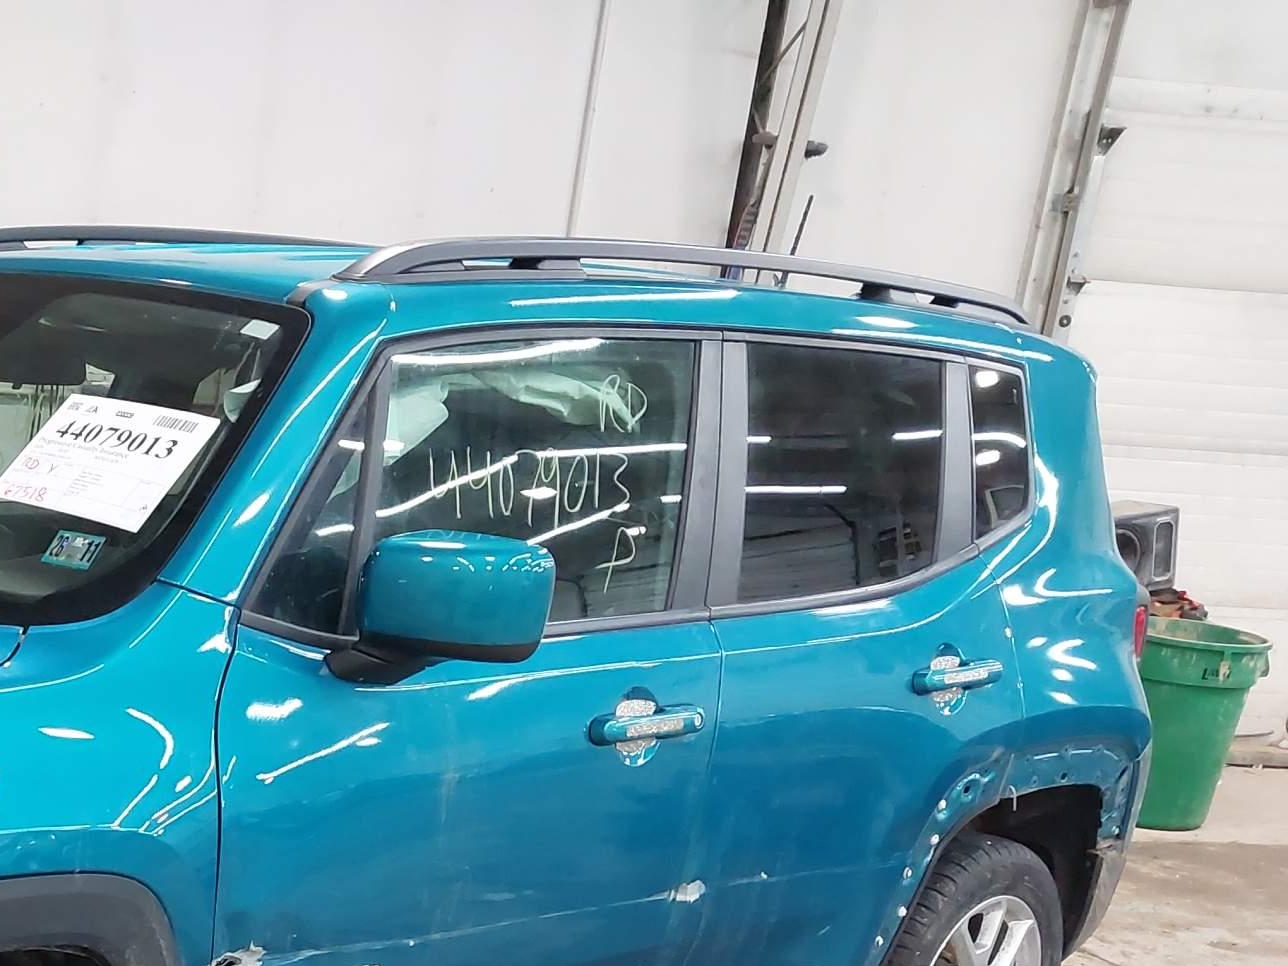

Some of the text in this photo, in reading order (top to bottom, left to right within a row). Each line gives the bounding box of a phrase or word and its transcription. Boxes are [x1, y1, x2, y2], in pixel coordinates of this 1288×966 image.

[56, 419, 179, 460] 44079013
[429, 446, 631, 529] 44079013
[49, 535, 102, 563] 26 11
